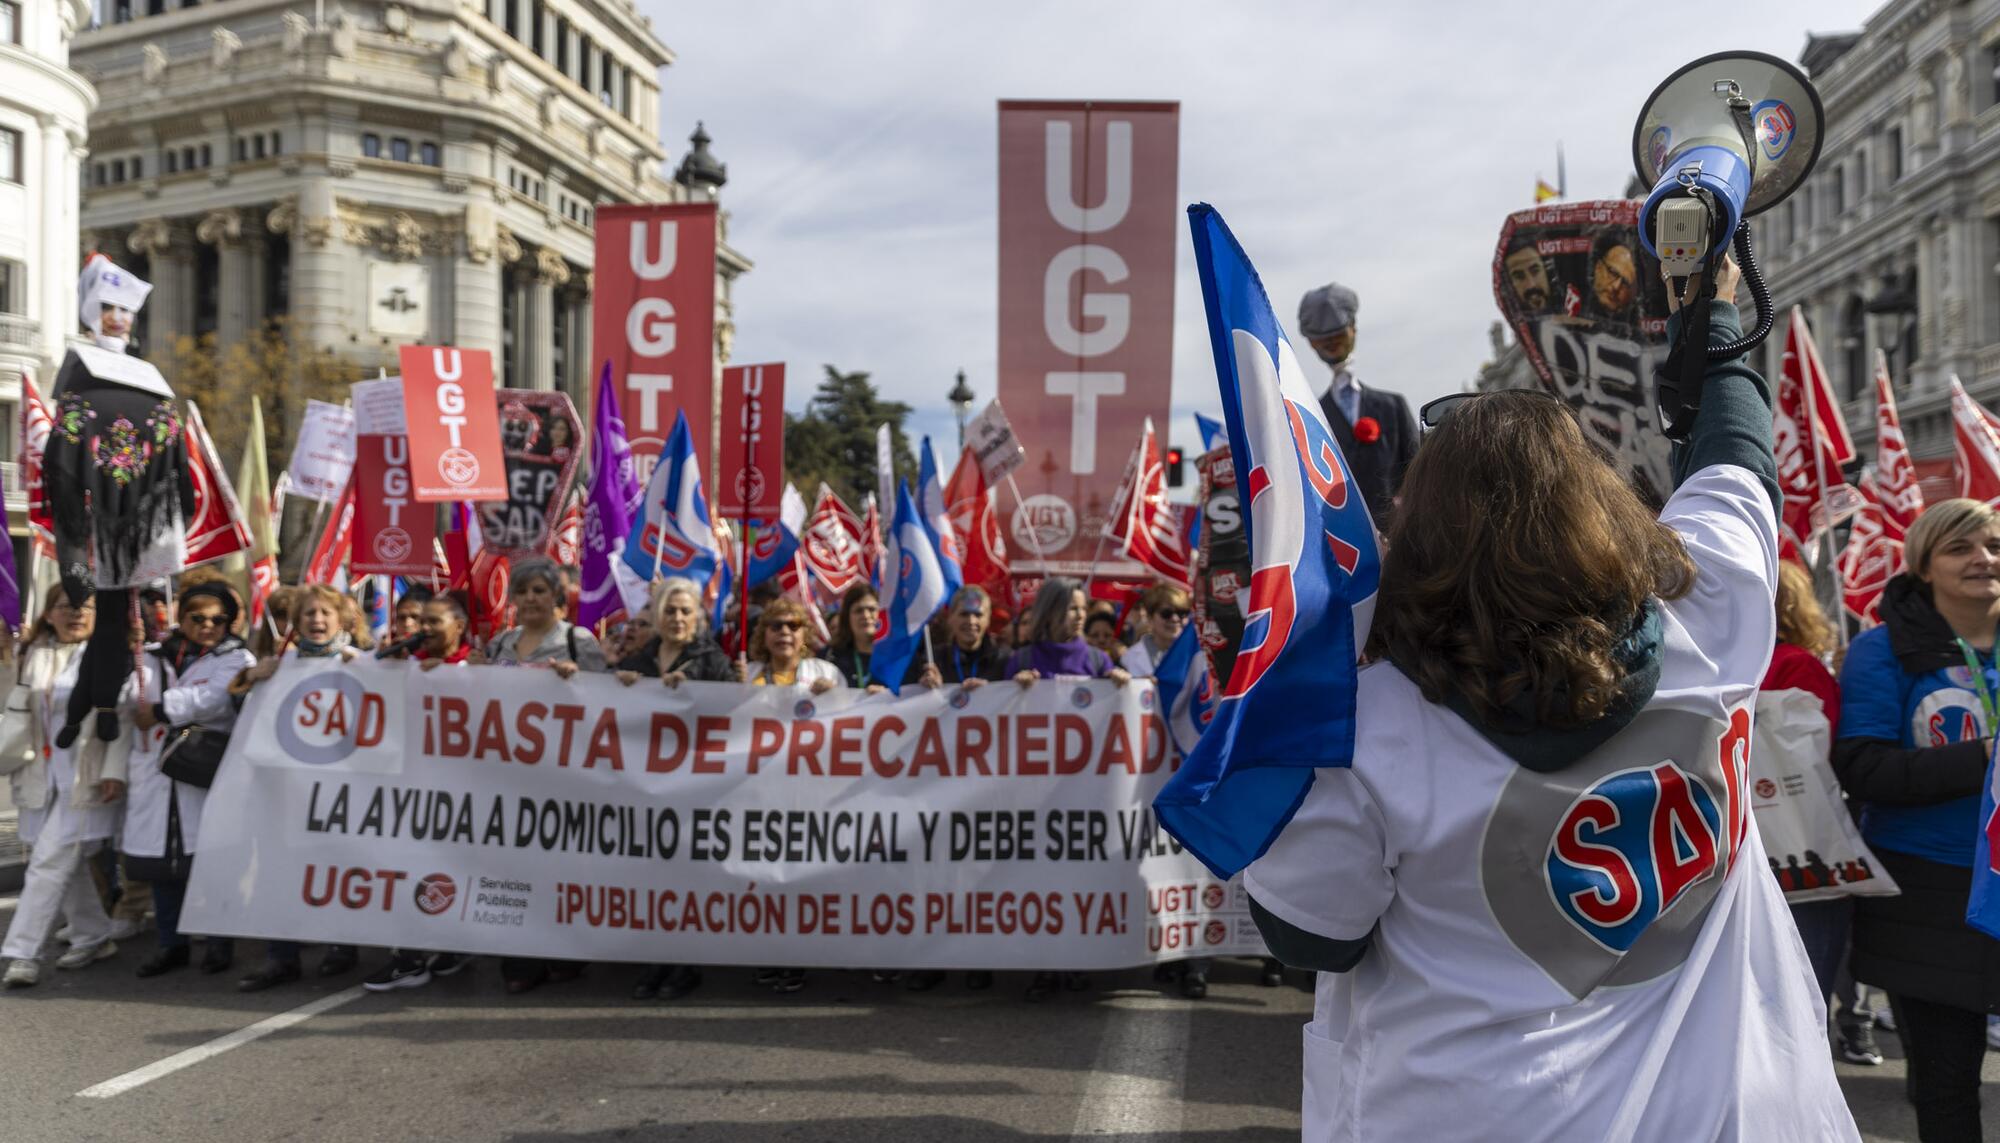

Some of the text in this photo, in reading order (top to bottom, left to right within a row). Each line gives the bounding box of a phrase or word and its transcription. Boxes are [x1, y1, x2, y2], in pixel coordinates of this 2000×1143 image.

[1538, 209, 1563, 225] UGT
[1589, 208, 1614, 222] UGT
[1537, 239, 1563, 254] UGT
[1042, 119, 1133, 475] UGT
[626, 220, 679, 433] UGT
[433, 347, 467, 449] UGT
[383, 435, 409, 528] UGT
[482, 501, 547, 549] SAD
[299, 690, 386, 748] SAD
[423, 695, 625, 772] ¡BASTA
[646, 712, 731, 776] DE
[306, 781, 348, 835] LA
[358, 785, 474, 845] AYUDA
[482, 794, 506, 847] A
[515, 796, 681, 862] DOMICILIO
[689, 808, 732, 863] ES
[742, 809, 907, 864] ESENCIAL
[917, 810, 941, 863] Y
[950, 809, 1036, 863] DEBE
[1046, 808, 1109, 862] SER
[302, 864, 408, 912] UGT
[480, 876, 532, 893] Servicios
[1147, 883, 1198, 916] UGT
[472, 909, 525, 928] Madrid
[556, 882, 1130, 936] ¡PUBLICACIÓN DE LOS PLIEGOS YA!
[1148, 920, 1200, 953] UGT
